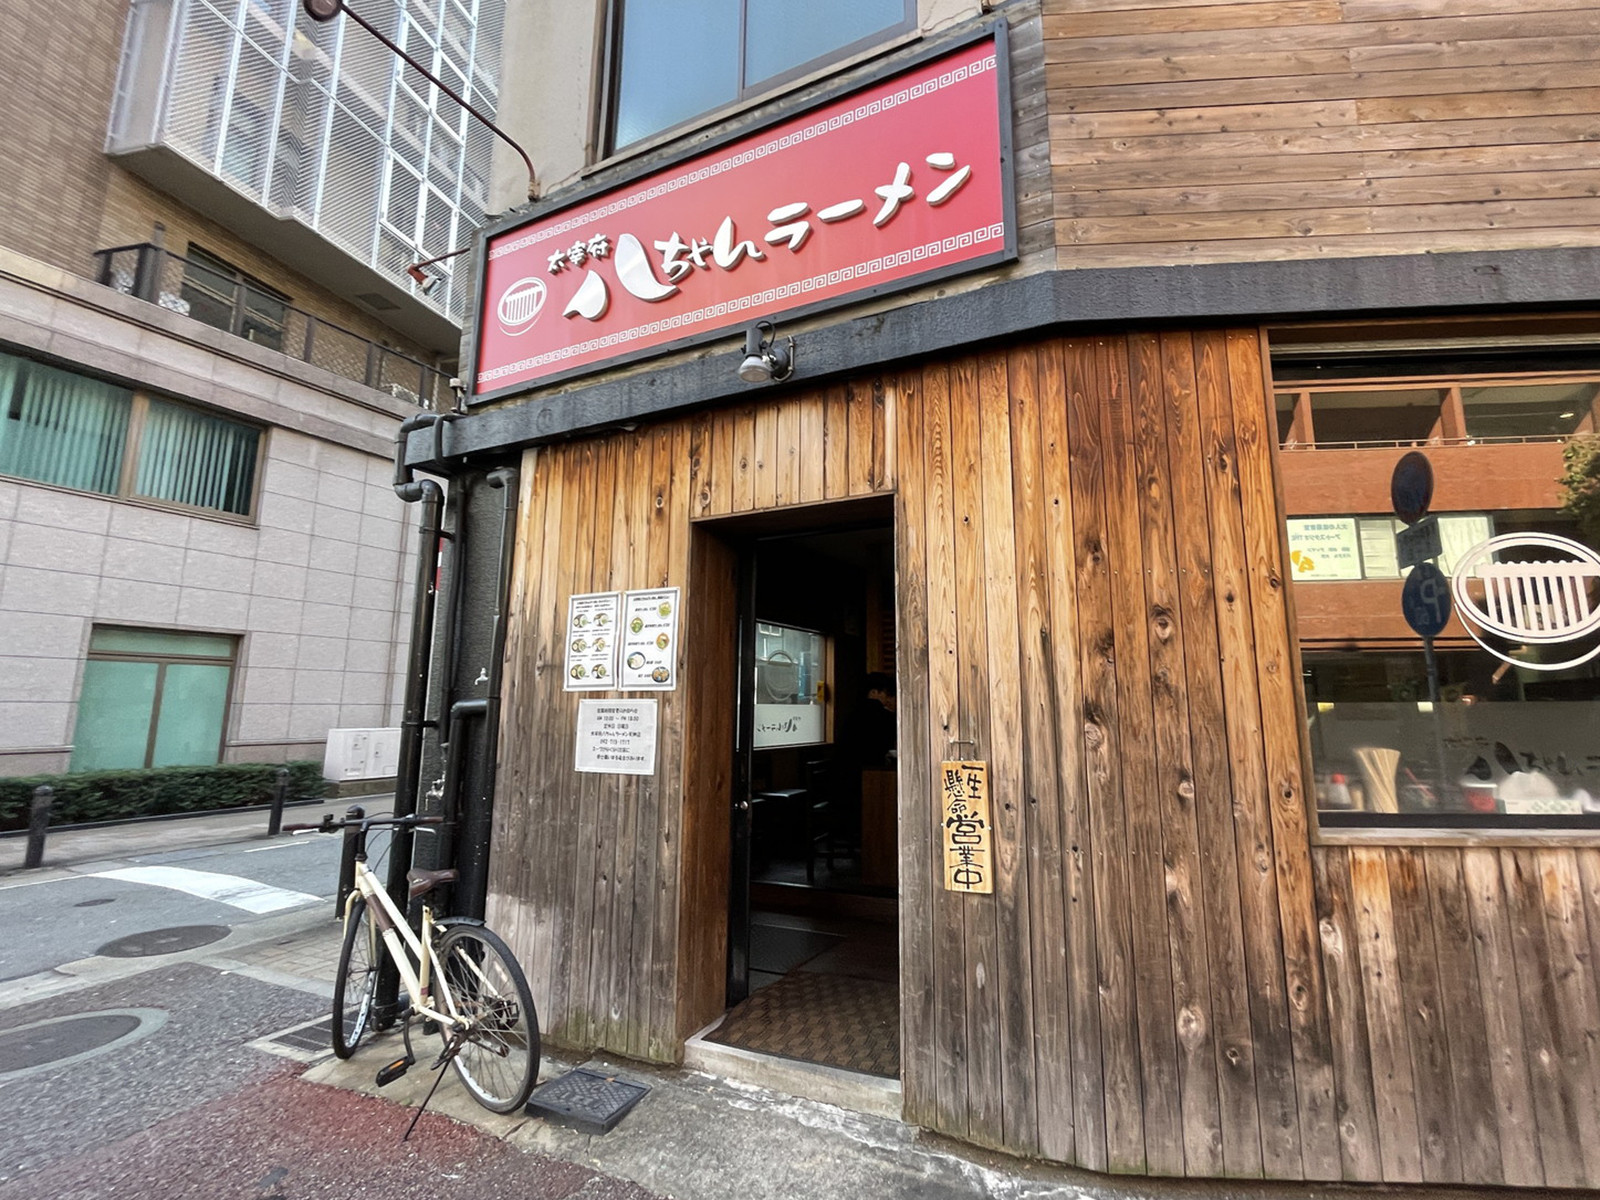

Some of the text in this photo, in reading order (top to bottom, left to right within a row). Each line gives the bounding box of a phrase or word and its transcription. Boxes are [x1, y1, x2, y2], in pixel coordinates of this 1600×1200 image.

[546, 232, 613, 274] 太宰府
[562, 152, 972, 321] 八ちゃんラーメン
[946, 811, 985, 889] 営業中
